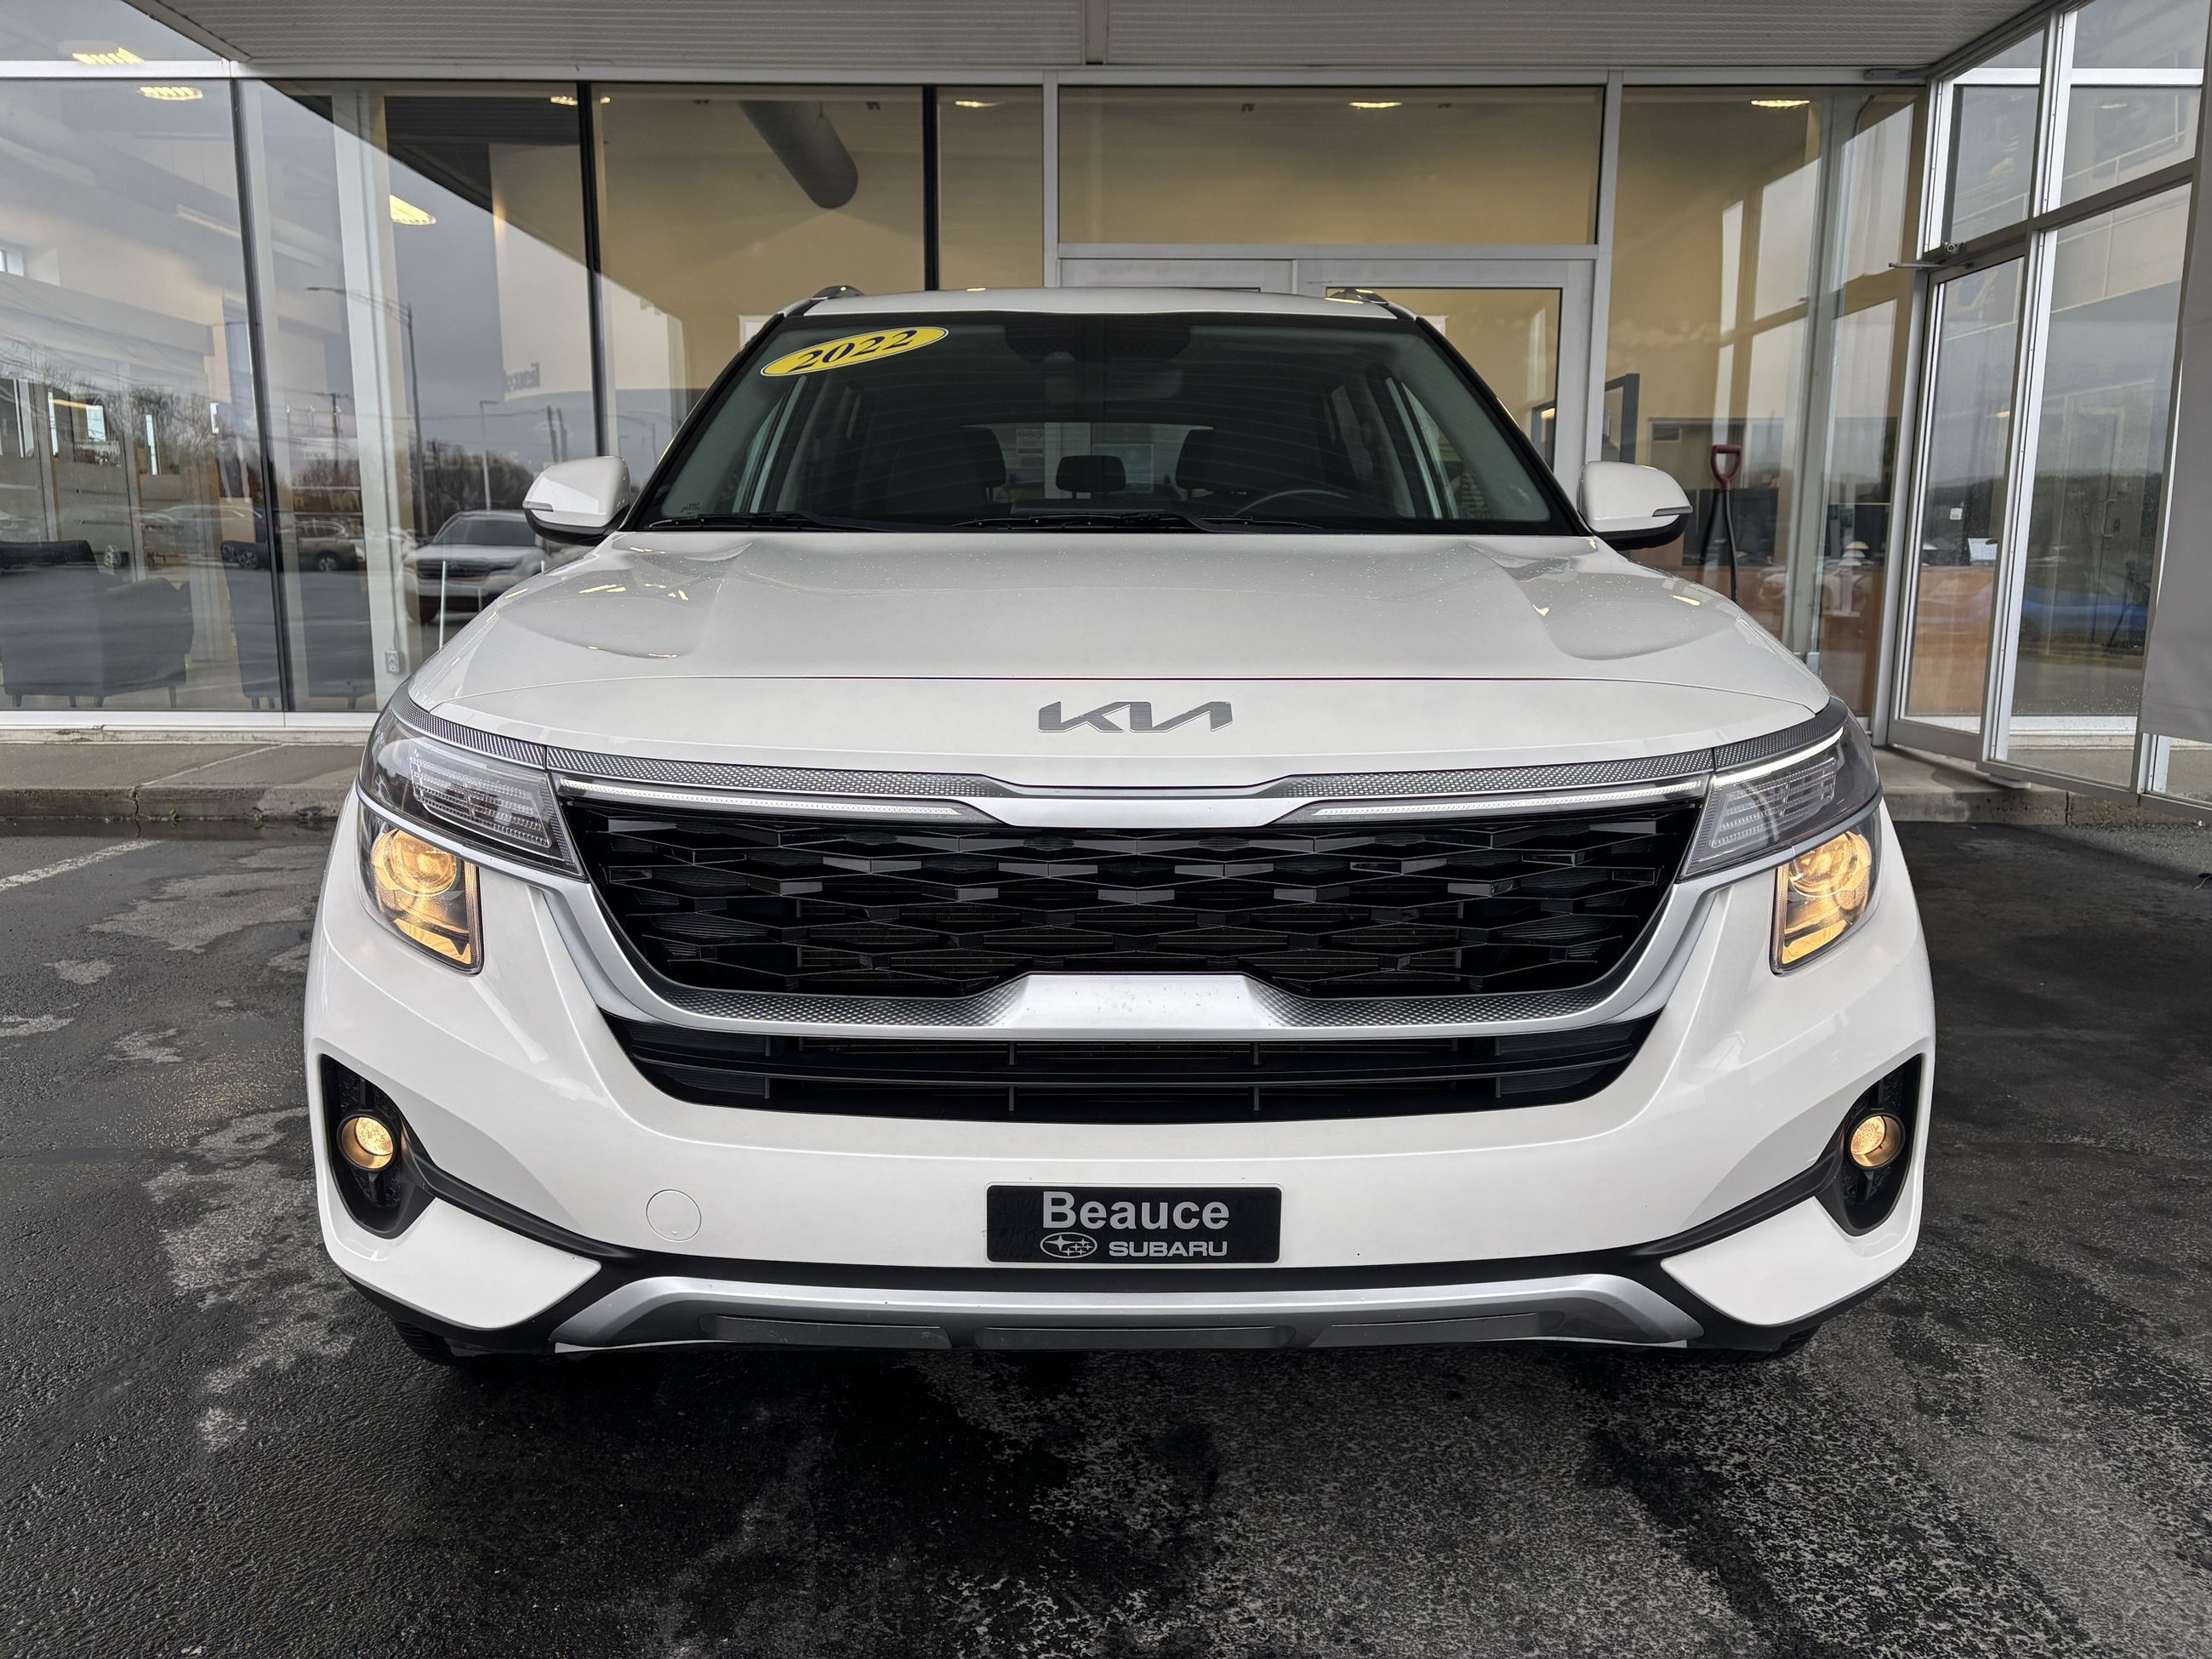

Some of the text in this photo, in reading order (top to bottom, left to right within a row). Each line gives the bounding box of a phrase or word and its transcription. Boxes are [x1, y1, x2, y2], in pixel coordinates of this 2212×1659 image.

[786, 330, 917, 373] 2022
[1043, 1191, 1229, 1230] Beauce
[1109, 1241, 1228, 1257] SUBARU
